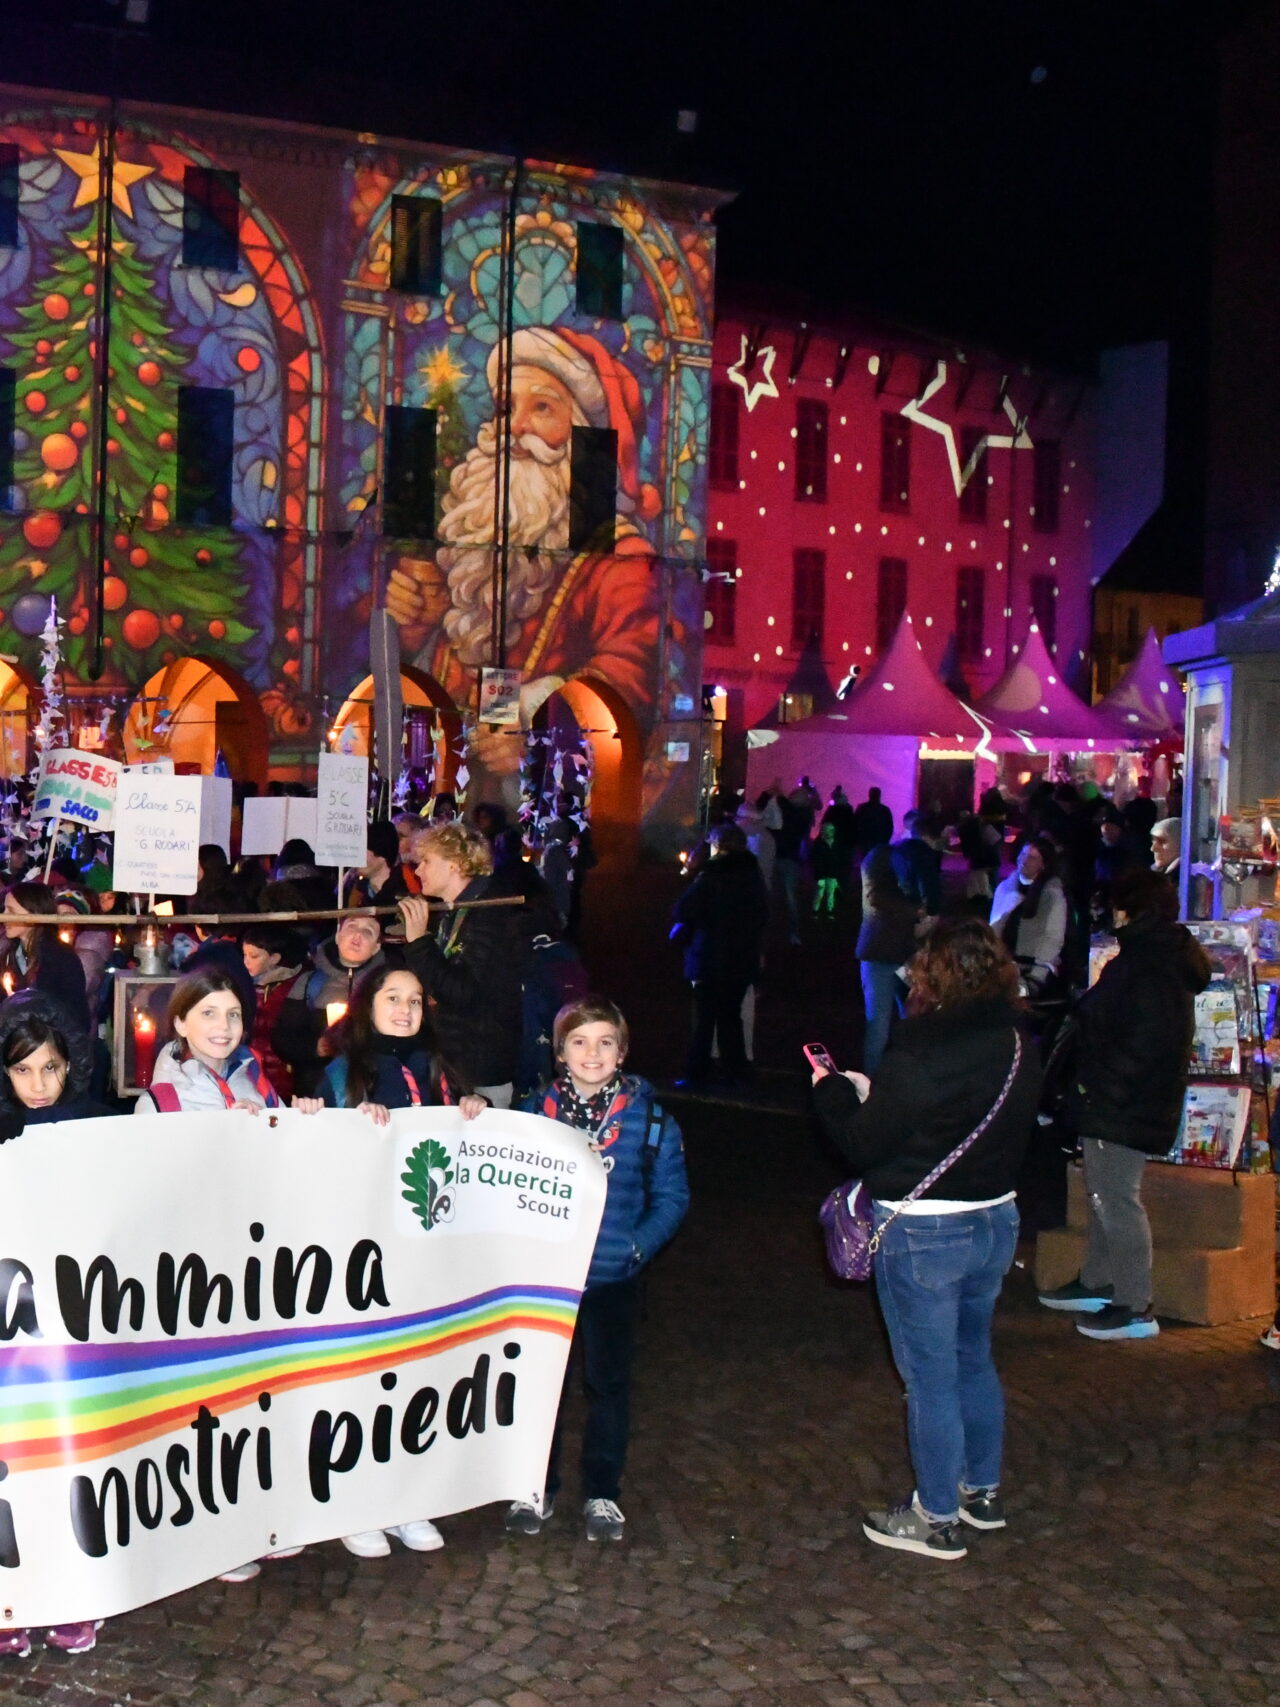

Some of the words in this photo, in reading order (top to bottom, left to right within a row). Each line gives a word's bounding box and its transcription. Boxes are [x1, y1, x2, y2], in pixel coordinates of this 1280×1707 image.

[45, 758, 106, 784] CLASSE
[125, 792, 169, 811] Classe
[457, 1140, 578, 1176] Associazione
[455, 1162, 471, 1185] la
[477, 1162, 574, 1200] Quercia
[516, 1193, 571, 1221] Scout
[70, 1391, 273, 1559] nostri
[307, 1341, 522, 1504] piedi
